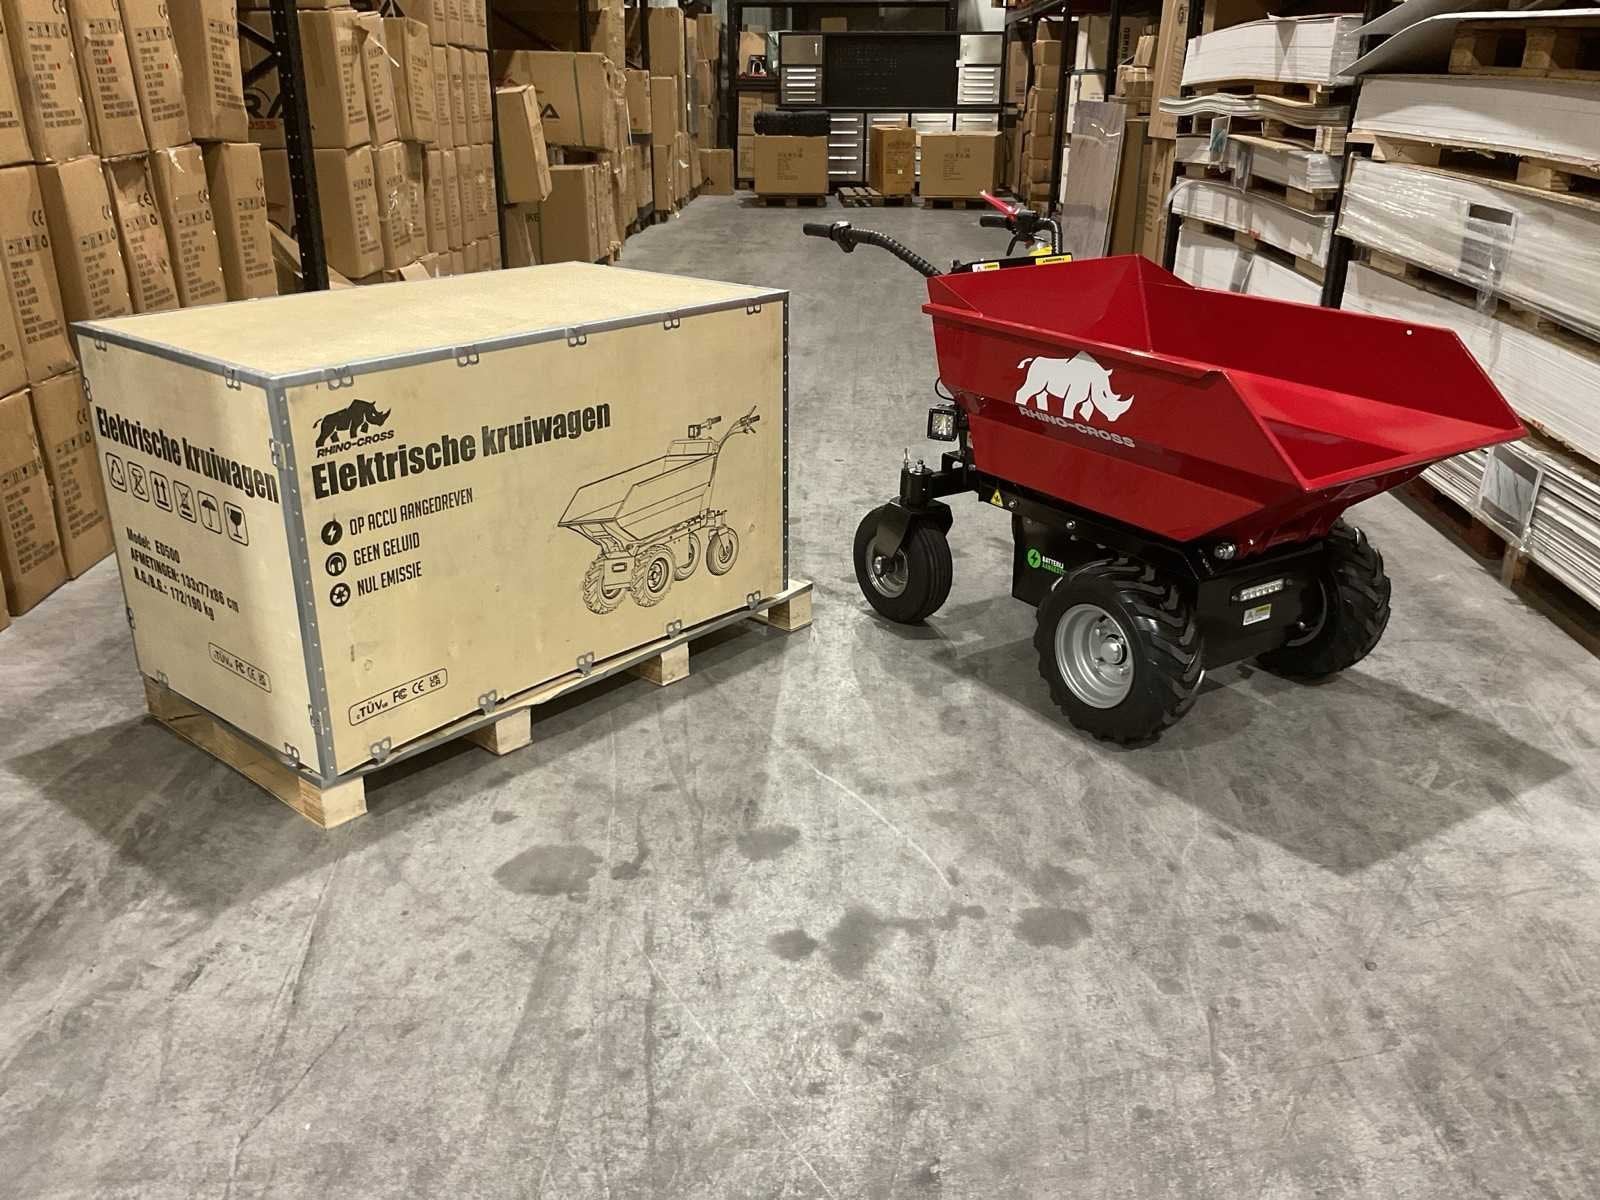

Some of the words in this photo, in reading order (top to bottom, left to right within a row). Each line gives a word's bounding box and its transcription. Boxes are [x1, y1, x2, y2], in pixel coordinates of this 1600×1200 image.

[137, 192, 152, 208] CE
[32, 209, 45, 226] CE
[77, 409, 88, 424] CE
[1019, 406, 1136, 449] RHINO-CROSS
[96, 407, 182, 466] Elektrische
[183, 437, 280, 503] kruiwagen
[311, 434, 476, 499] Elektrische
[481, 403, 611, 457] kruiwagen
[317, 430, 394, 458] RHINO-CROSS
[350, 517, 367, 536] OP
[368, 507, 397, 531] ACCU
[400, 487, 473, 521] AANGEDREVEN
[126, 526, 151, 550] Model:
[353, 543, 381, 566] GEEN
[382, 532, 420, 557] GELUID
[130, 547, 180, 584] AFMETINGEN:
[357, 575, 379, 596] NUL
[380, 560, 422, 588] EMISSIE
[203, 601, 215, 621] kg
[412, 679, 424, 694] CE
